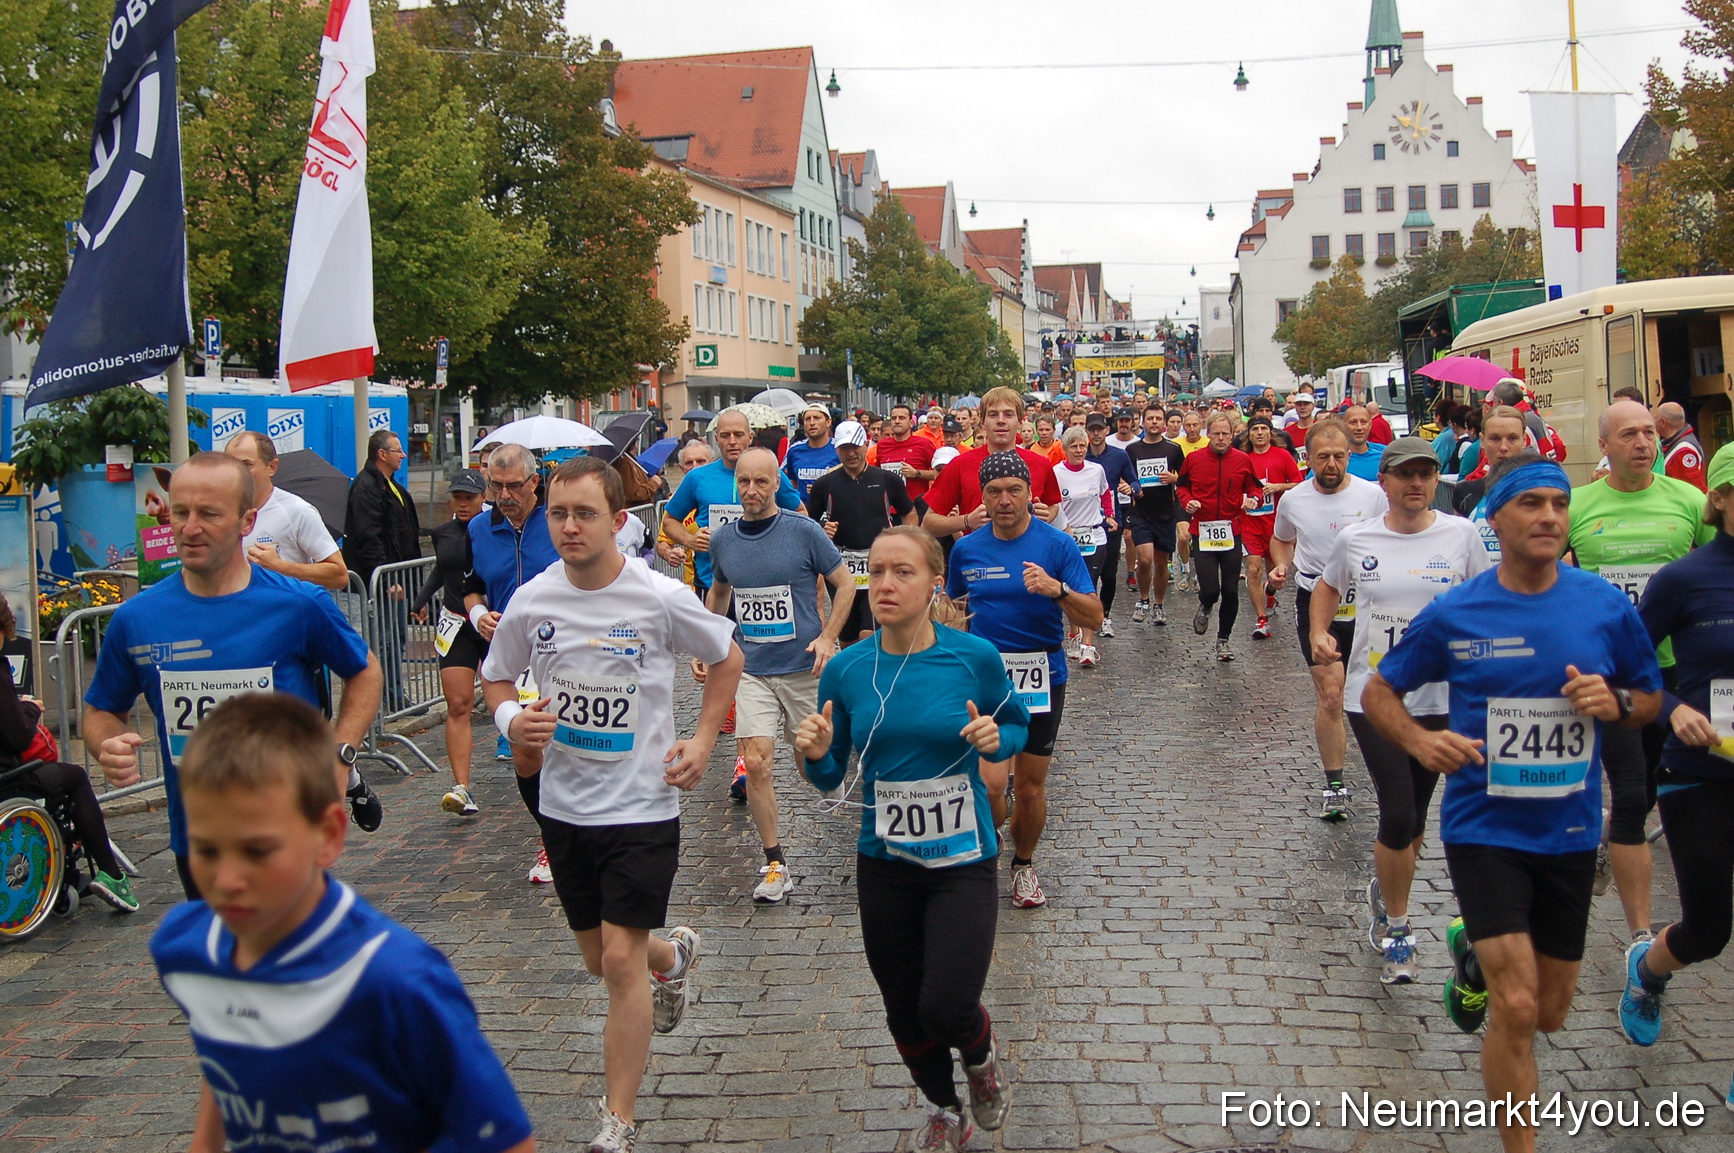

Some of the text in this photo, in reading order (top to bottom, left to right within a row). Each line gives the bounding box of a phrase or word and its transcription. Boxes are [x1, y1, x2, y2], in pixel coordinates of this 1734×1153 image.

[698, 347, 714, 364] D
[1530, 336, 1579, 365] Bayerisches
[1104, 360, 1134, 368] START
[1530, 366, 1553, 386] Rotes
[1533, 391, 1553, 408] reuz
[169, 536, 175, 544] S
[1206, 527, 1227, 540] 186
[848, 561, 870, 574] 54
[752, 591, 781, 599] Neumarkt
[741, 600, 788, 622] 2856
[1371, 613, 1395, 623] PARTL
[753, 626, 776, 635] Pierre
[163, 680, 253, 691] PARTL Neumarkt
[552, 676, 623, 693] PARTL Neumarkt
[557, 691, 630, 729] 2392
[1490, 707, 1578, 718] PARTL Neumarkt
[568, 731, 612, 749] Damian
[1499, 721, 1586, 759] 2443
[1519, 769, 1567, 784] Robert
[877, 787, 954, 799] PARTL Neumarkt
[886, 796, 965, 837] 2017
[910, 843, 948, 858] Maria
